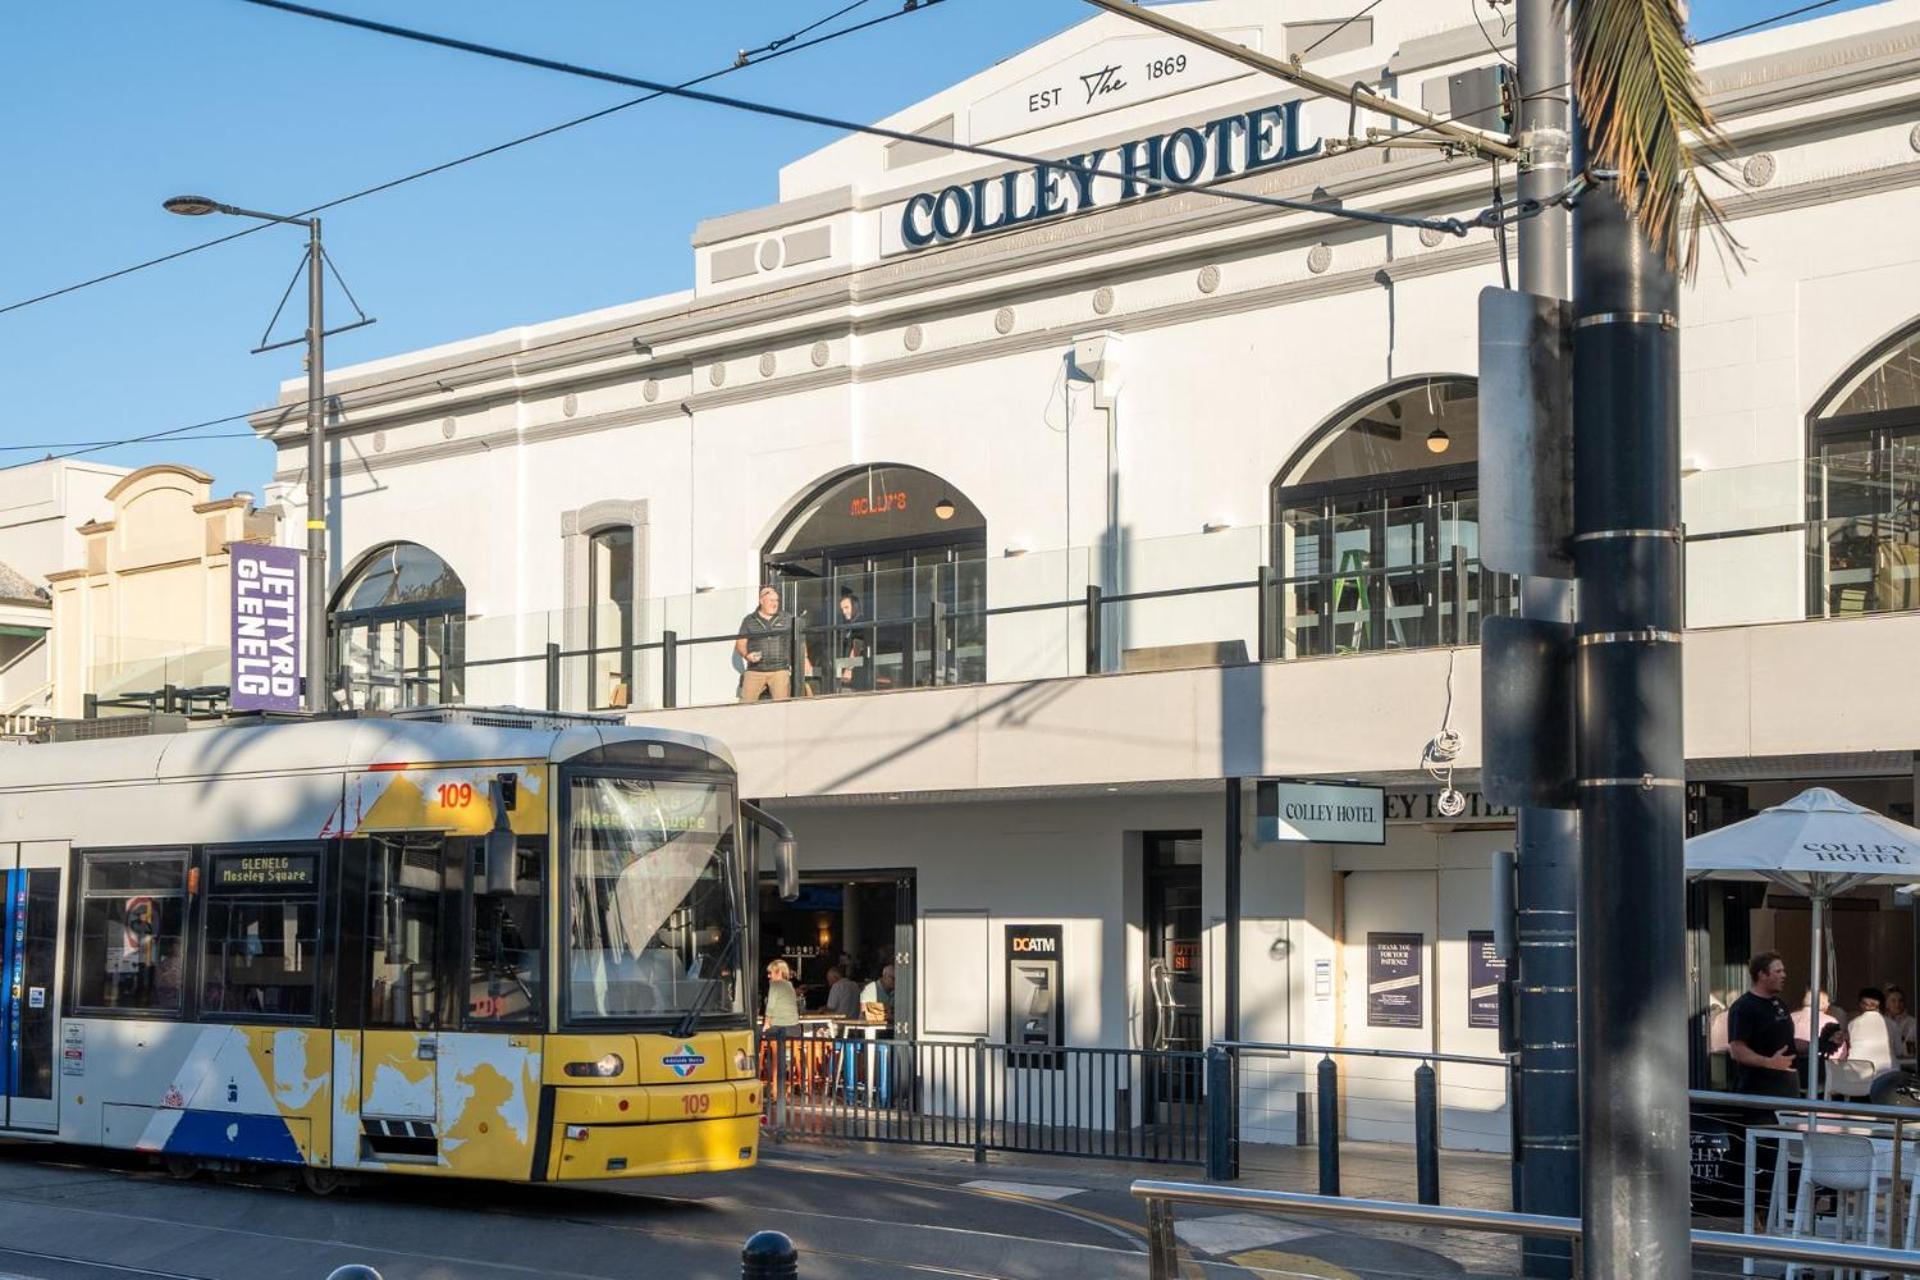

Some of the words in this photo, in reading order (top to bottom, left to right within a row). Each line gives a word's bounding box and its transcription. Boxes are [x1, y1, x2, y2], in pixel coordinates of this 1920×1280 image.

[1029, 87, 1062, 112] EST
[1080, 65, 1127, 105] The
[1145, 54, 1187, 81] 1869
[901, 149, 1102, 246] COLLEY
[1119, 98, 1325, 200] HOTEL
[237, 558, 271, 696] GLENELG
[437, 782, 472, 809] 109
[1285, 803, 1334, 821] COLLEY
[1337, 805, 1377, 823] HOTEL
[1803, 842, 1907, 854] COLLEY
[1816, 852, 1911, 865] HOTEL
[241, 857, 289, 870] GLENELG
[223, 869, 265, 883] Moseley
[268, 868, 306, 883] Square
[682, 1093, 710, 1115] 109
